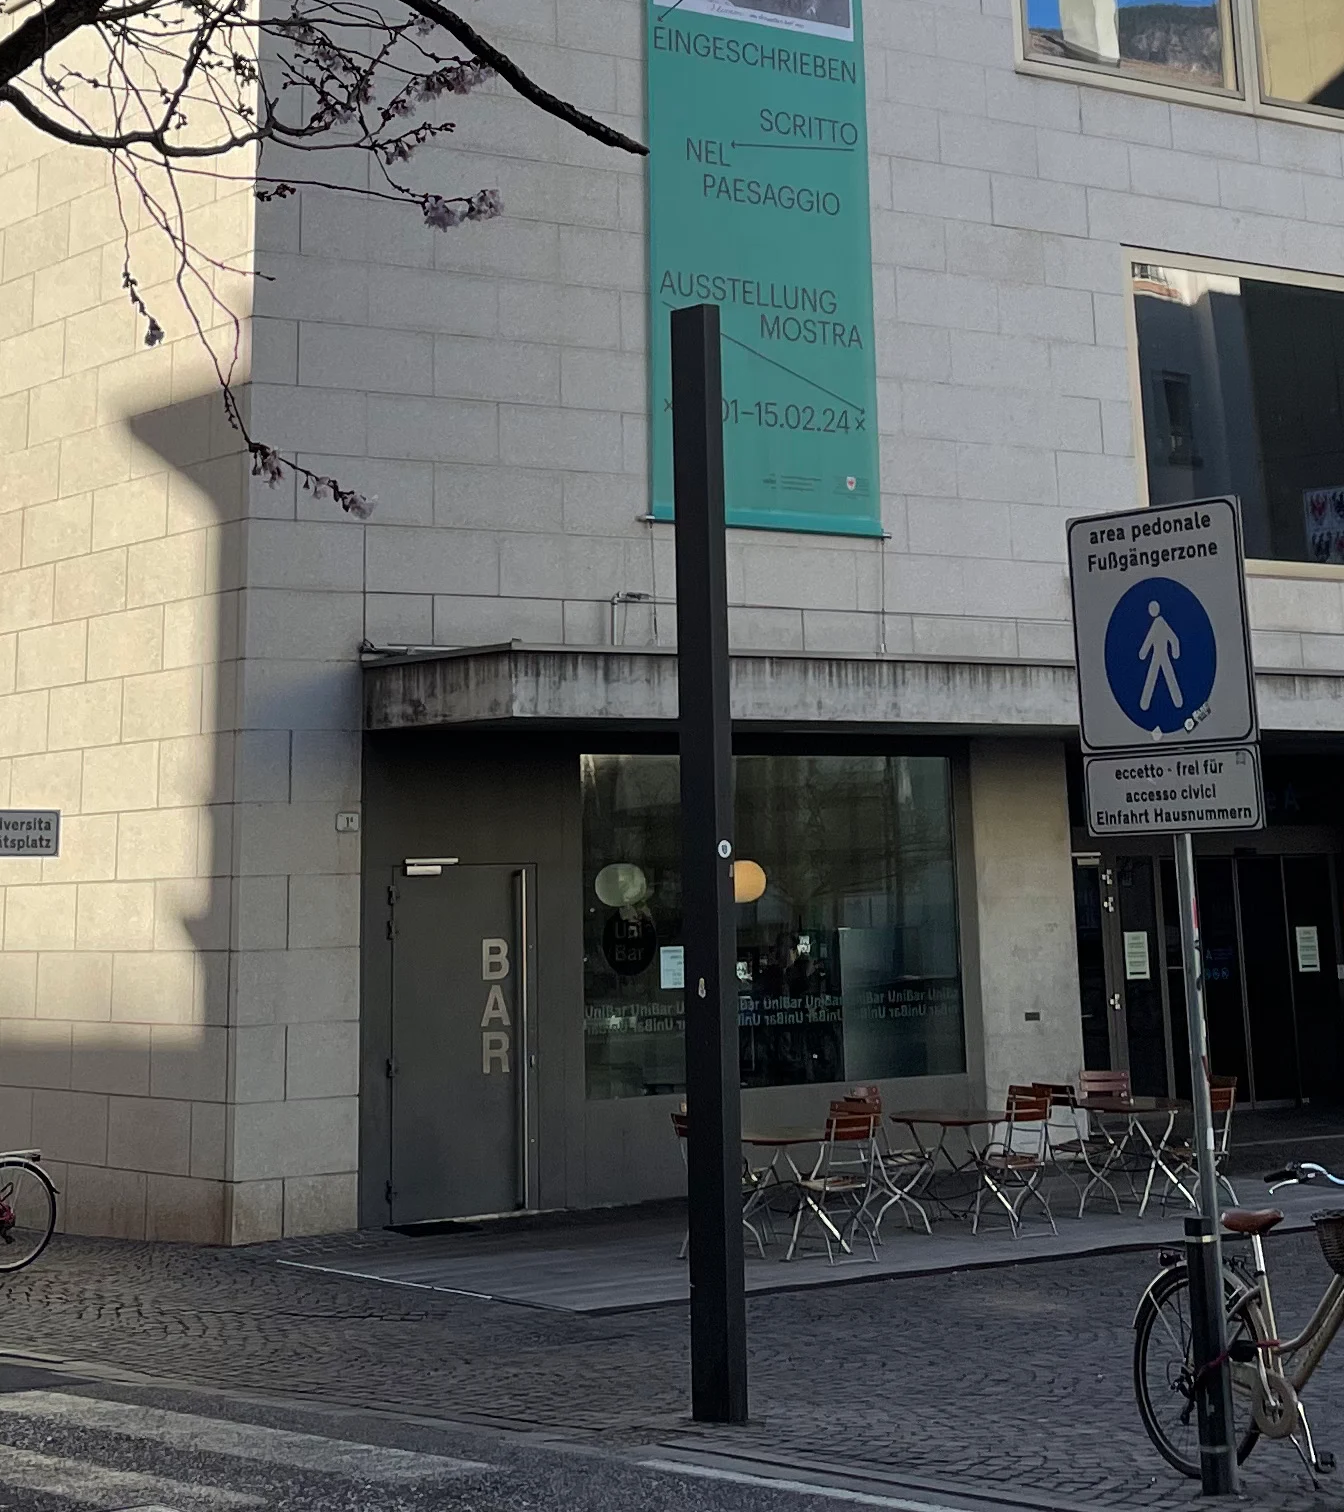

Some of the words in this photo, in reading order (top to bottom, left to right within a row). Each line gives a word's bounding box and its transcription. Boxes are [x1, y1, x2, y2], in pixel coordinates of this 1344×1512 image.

[653, 25, 856, 85] EINGESCHRIEBEN
[760, 108, 858, 146] SCRITTO
[686, 136, 731, 167] NEL
[703, 173, 840, 216] PAESAGGIO
[660, 270, 837, 315] AUSSTELLUNG
[760, 313, 863, 350] MOSTRA
[1089, 527, 1125, 544] area
[1131, 511, 1211, 542] pedonale
[1088, 541, 1218, 572] Fußgängerzone
[1115, 764, 1164, 780] eccetto
[1176, 760, 1199, 776] frei
[1203, 759, 1223, 775] für
[1126, 788, 1177, 803] accesso
[1181, 783, 1216, 800] civici
[1096, 808, 1149, 825] Einfahrt
[1154, 806, 1252, 823] Hausnummern
[480, 938, 512, 1075] BAR
[764, 995, 802, 1010] UniBar
